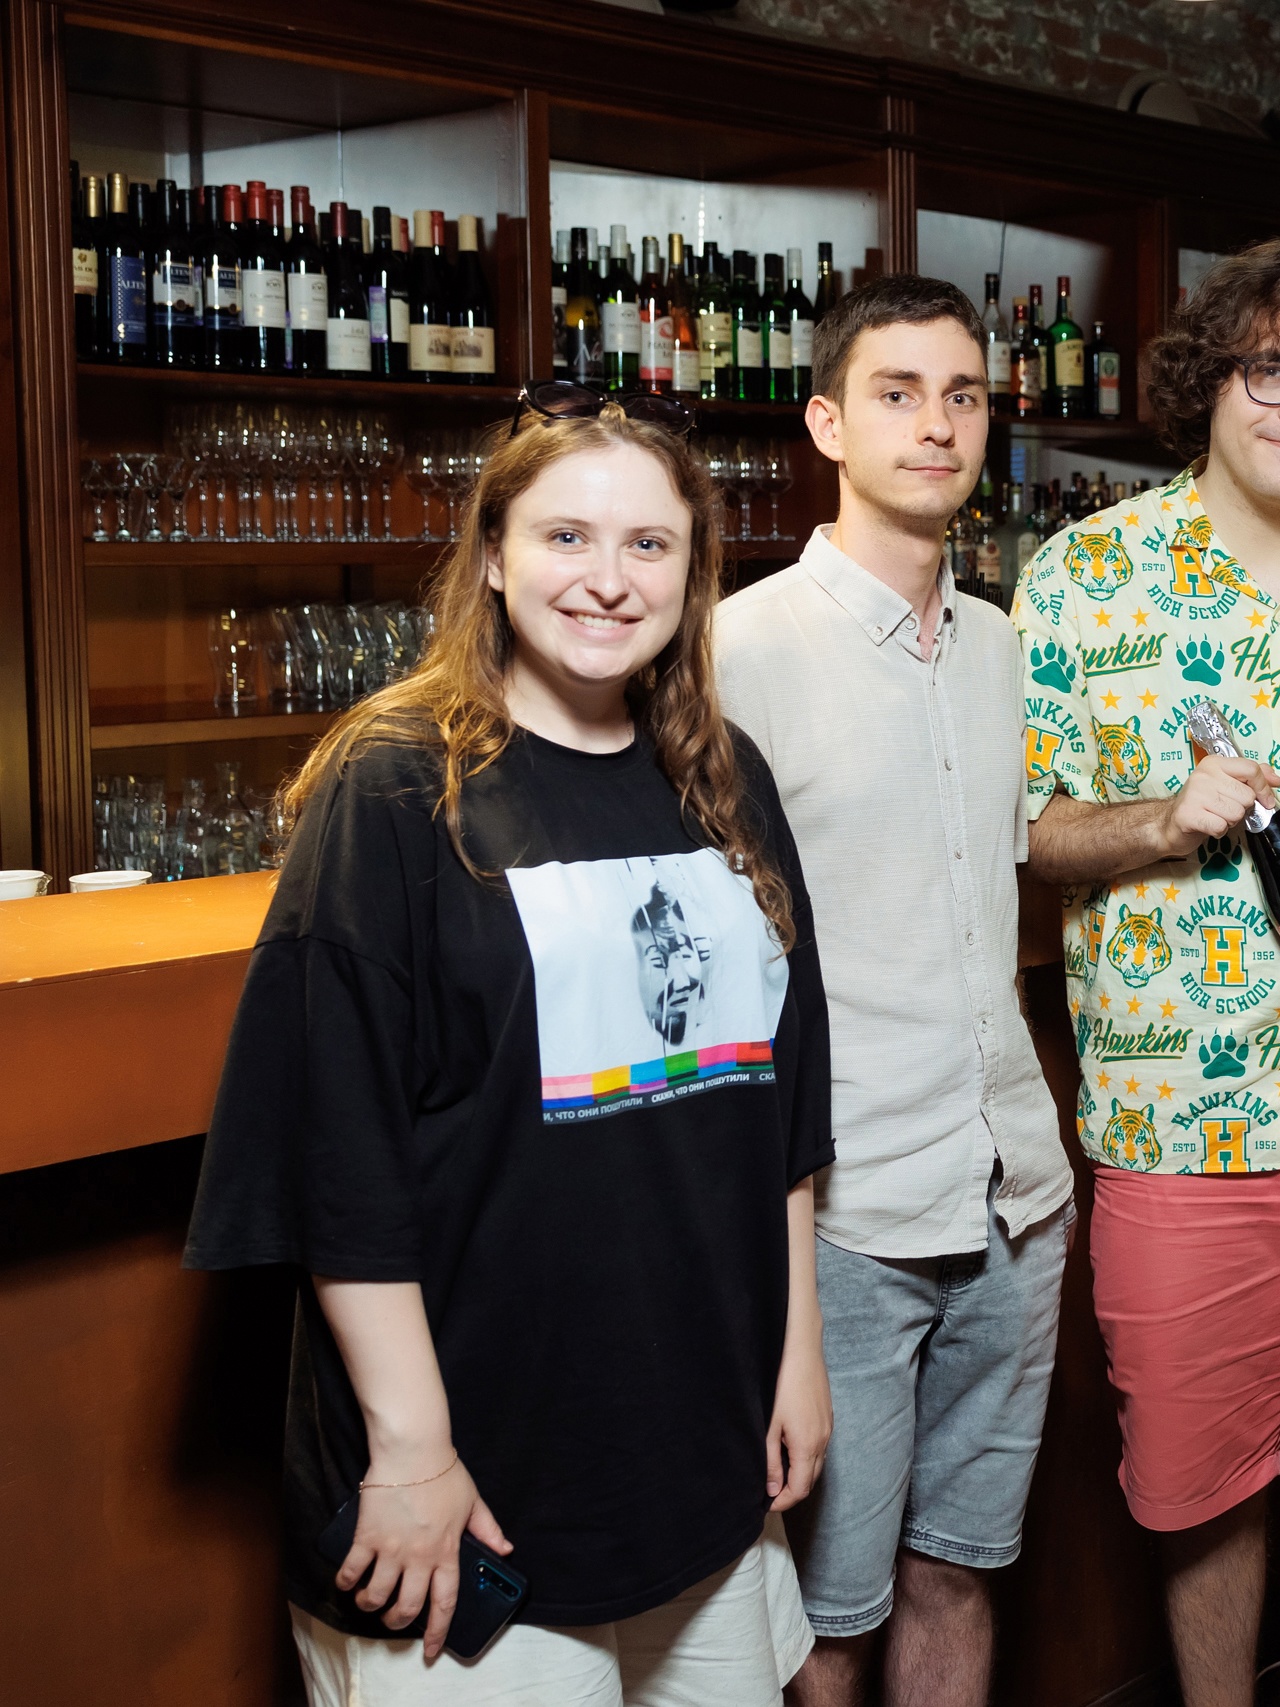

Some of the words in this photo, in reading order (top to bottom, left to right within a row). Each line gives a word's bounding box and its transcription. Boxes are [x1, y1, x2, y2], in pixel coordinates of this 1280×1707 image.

[1036, 565, 1056, 582] 1952
[1141, 562, 1166, 572] ESTD
[1146, 583, 1184, 618] HIGH
[1188, 586, 1241, 620] SCHOOL
[1082, 633, 1168, 678] wkins
[1026, 697, 1086, 754] WKINS
[1061, 761, 1082, 776] 1952
[1160, 750, 1183, 761] ESTD
[1243, 749, 1260, 760] 952
[1176, 894, 1274, 938] HAWKINS
[1180, 947, 1200, 958] ESTD
[1199, 925, 1249, 987] H
[1252, 950, 1275, 961] 1952
[1180, 972, 1212, 1010] HIGH
[1215, 977, 1277, 1015] SCHOOL
[1091, 1017, 1194, 1063] Hawkins
[675, 1085, 688, 1096] ЧТО
[688, 1080, 705, 1092] ОНИ
[705, 1073, 750, 1088] ПОШУТИЛИ
[555, 1110, 576, 1120] ЧТО
[577, 1106, 599, 1118] ОНИ
[600, 1096, 643, 1114] ПОШУТИЛИ
[1171, 1091, 1279, 1131] HAWKINS
[1172, 1143, 1197, 1153] ESTD
[1199, 1117, 1251, 1173] H
[1254, 1140, 1277, 1150] 1952
